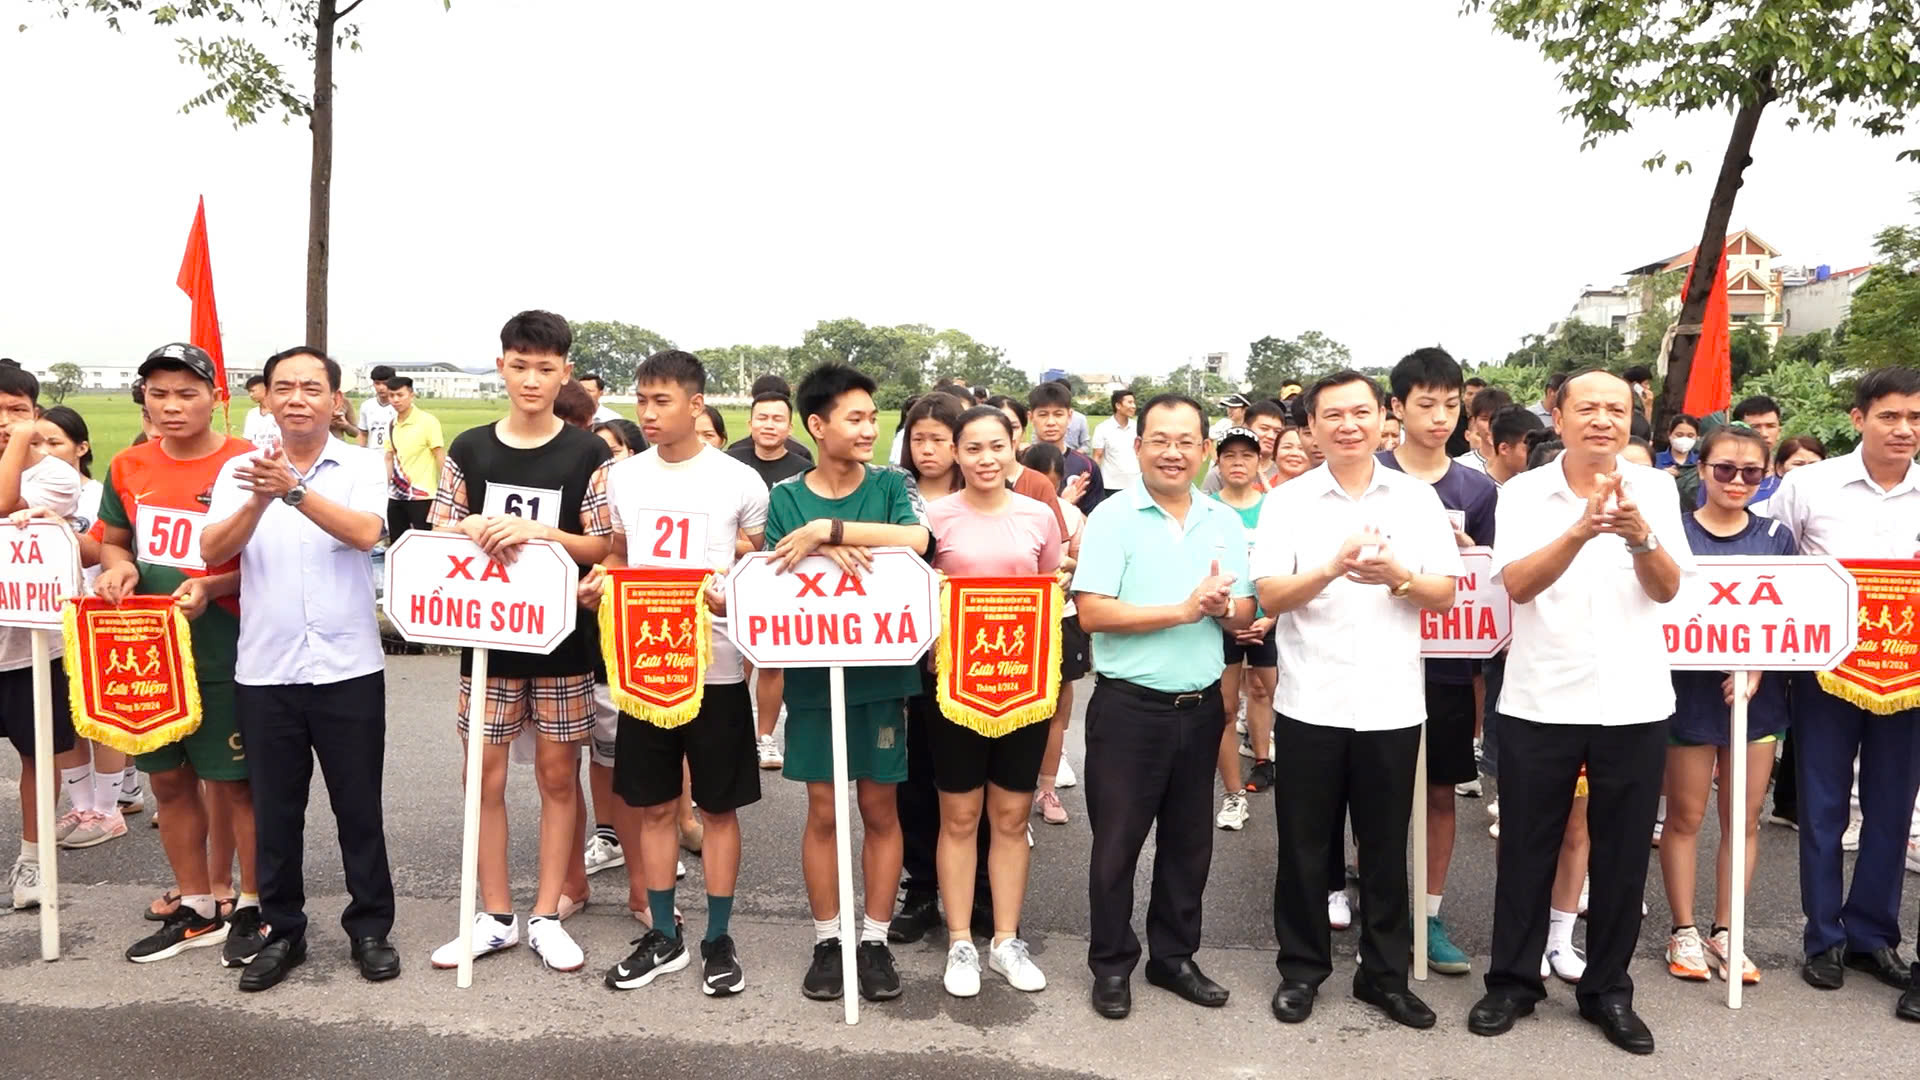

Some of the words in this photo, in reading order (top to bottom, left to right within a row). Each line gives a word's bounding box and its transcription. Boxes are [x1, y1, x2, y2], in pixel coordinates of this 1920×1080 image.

[10, 534, 44, 564] XÃ
[148, 515, 193, 560] 50
[652, 515, 690, 560] 21
[26, 576, 62, 612] PHÚ
[411, 586, 481, 629] HỒNG
[490, 601, 545, 635] SƠN
[1708, 575, 1784, 605] XÃ
[749, 607, 863, 646] PHÙNG
[873, 604, 919, 644] XÁ
[1662, 613, 1750, 653] ĐỒNG
[1761, 617, 1831, 653] TÂM
